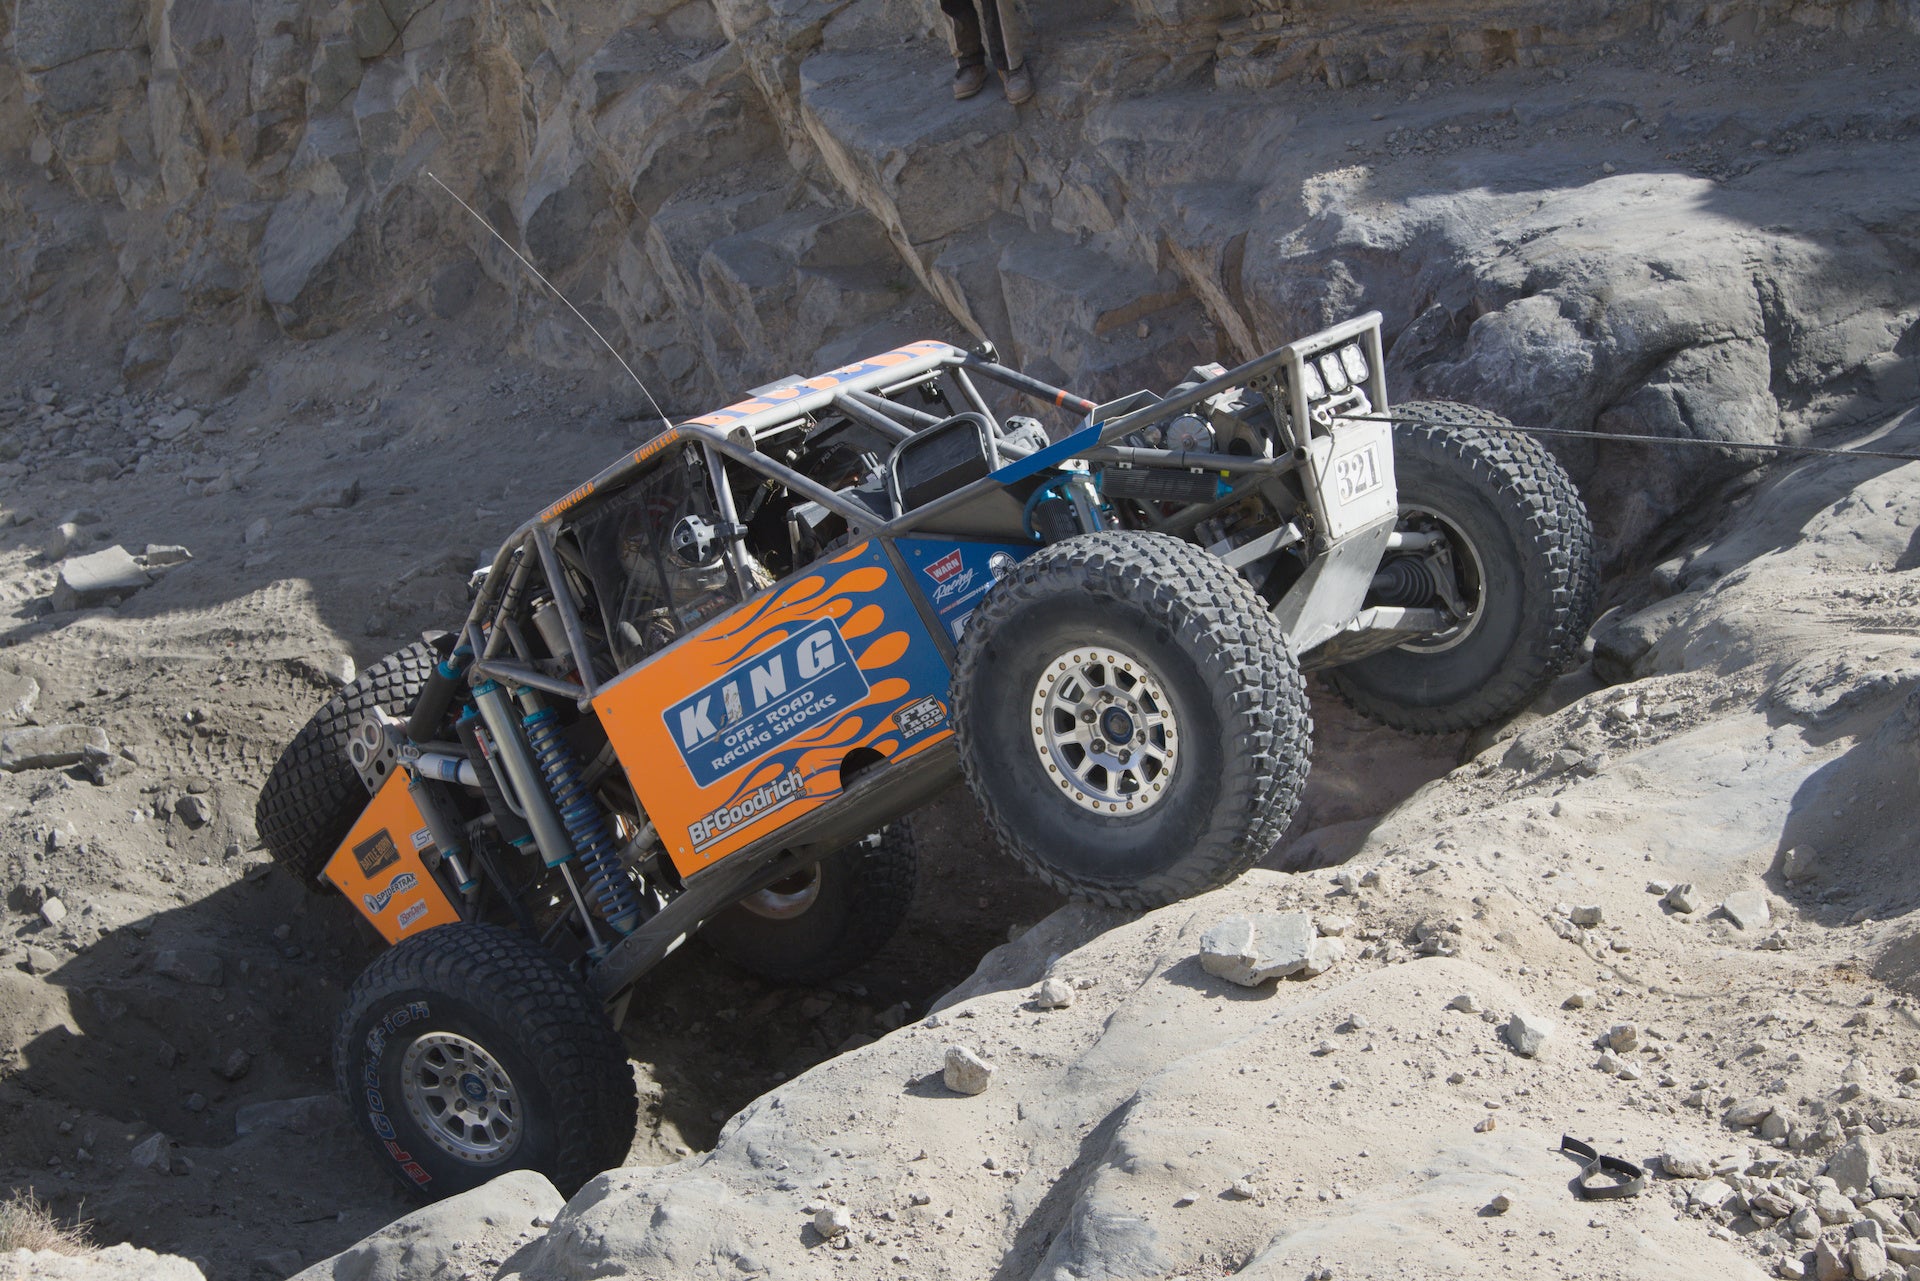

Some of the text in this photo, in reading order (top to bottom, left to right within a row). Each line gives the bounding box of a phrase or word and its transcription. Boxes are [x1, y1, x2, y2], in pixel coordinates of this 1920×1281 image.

[1337, 446, 1381, 500] 321
[932, 558, 960, 579] WARN
[932, 568, 979, 605] Racing
[679, 629, 836, 749] KING
[723, 724, 755, 747] OFF
[765, 690, 815, 723] ROAD
[900, 698, 938, 725] FK
[903, 713, 944, 739] ENDS
[909, 708, 940, 730] ROD
[711, 693, 837, 770] RACING SHOCKS
[687, 769, 805, 848] BFGoodrich
[376, 872, 416, 902] SPIDERTRAX
